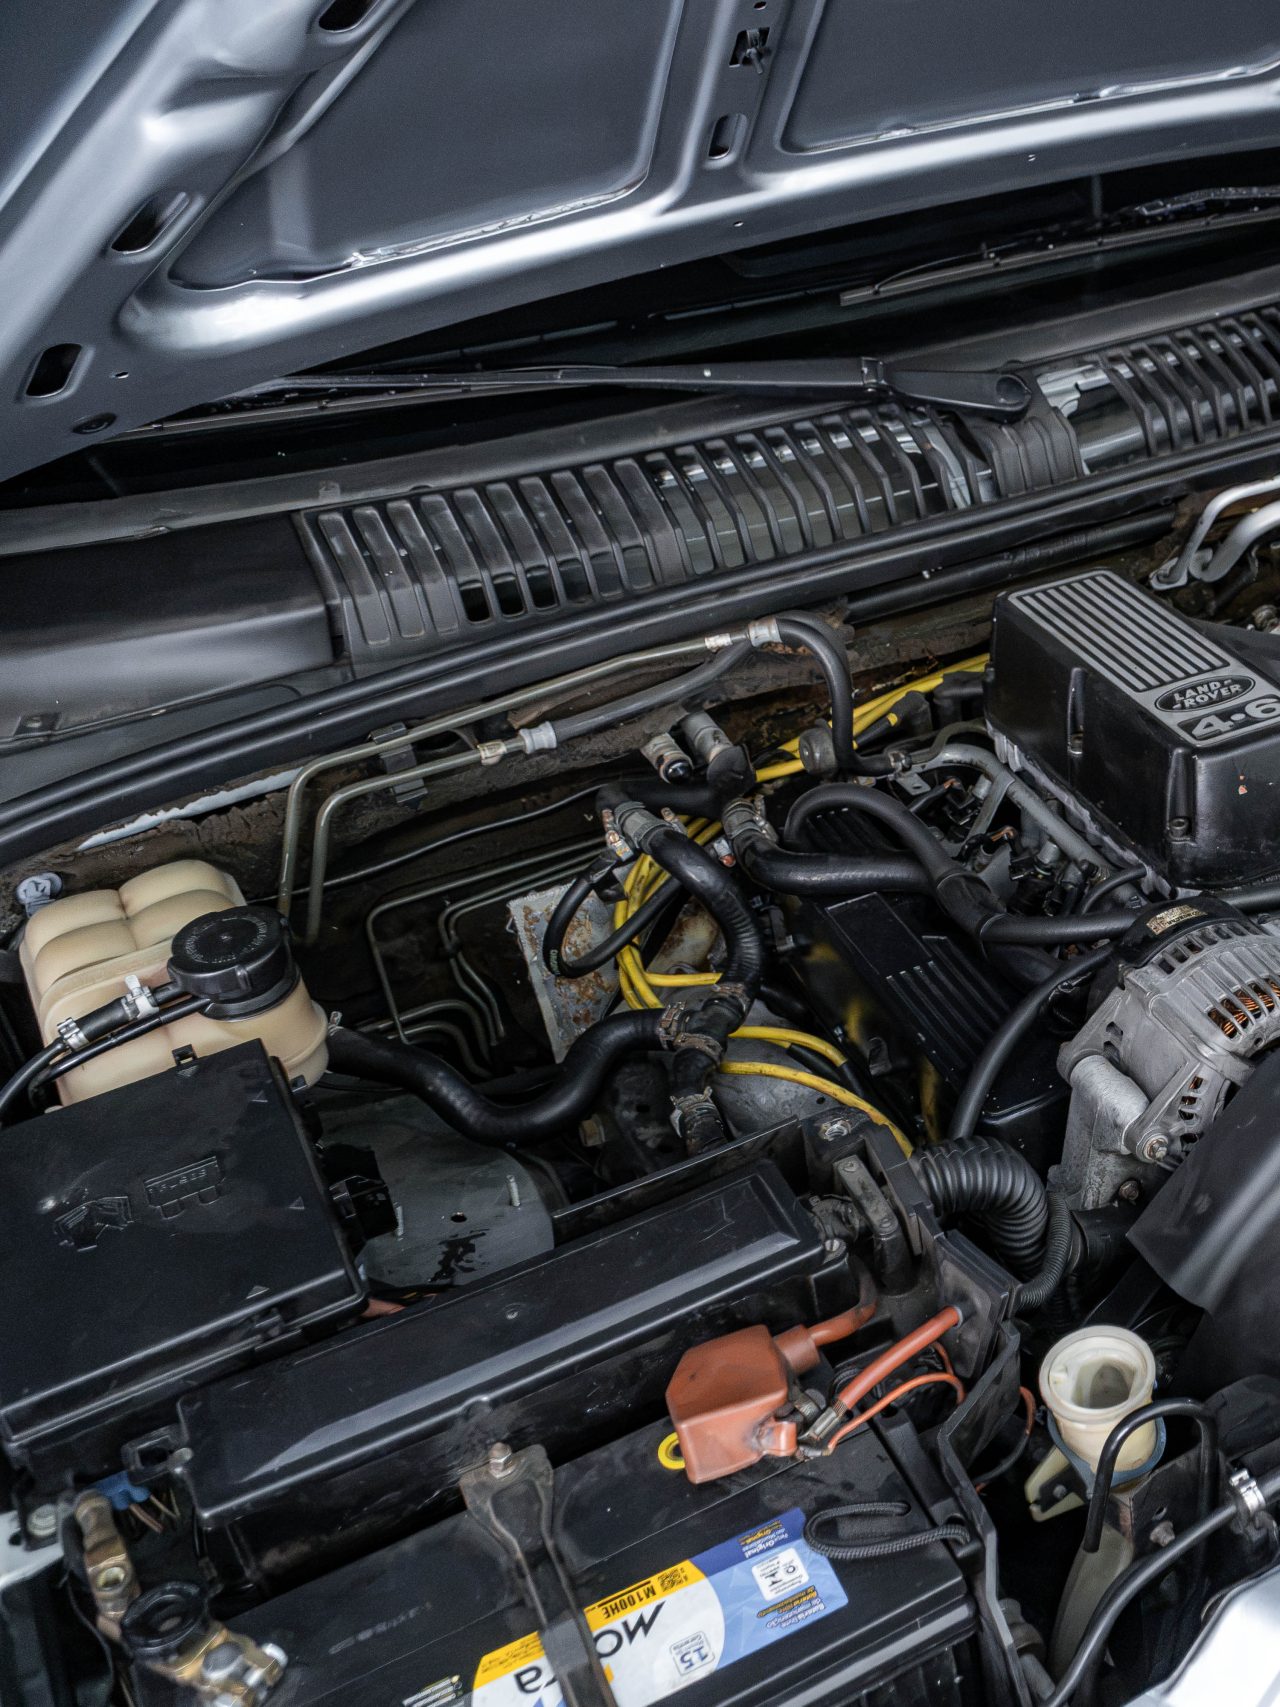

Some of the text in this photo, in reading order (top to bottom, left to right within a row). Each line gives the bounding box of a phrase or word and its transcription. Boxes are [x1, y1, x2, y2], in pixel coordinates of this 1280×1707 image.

[1174, 682, 1221, 701] LAND
[1185, 685, 1242, 709] ROVER
[744, 1539, 775, 1558] Original
[601, 1585, 657, 1619] M100HE
[678, 1645, 709, 1670] 15
